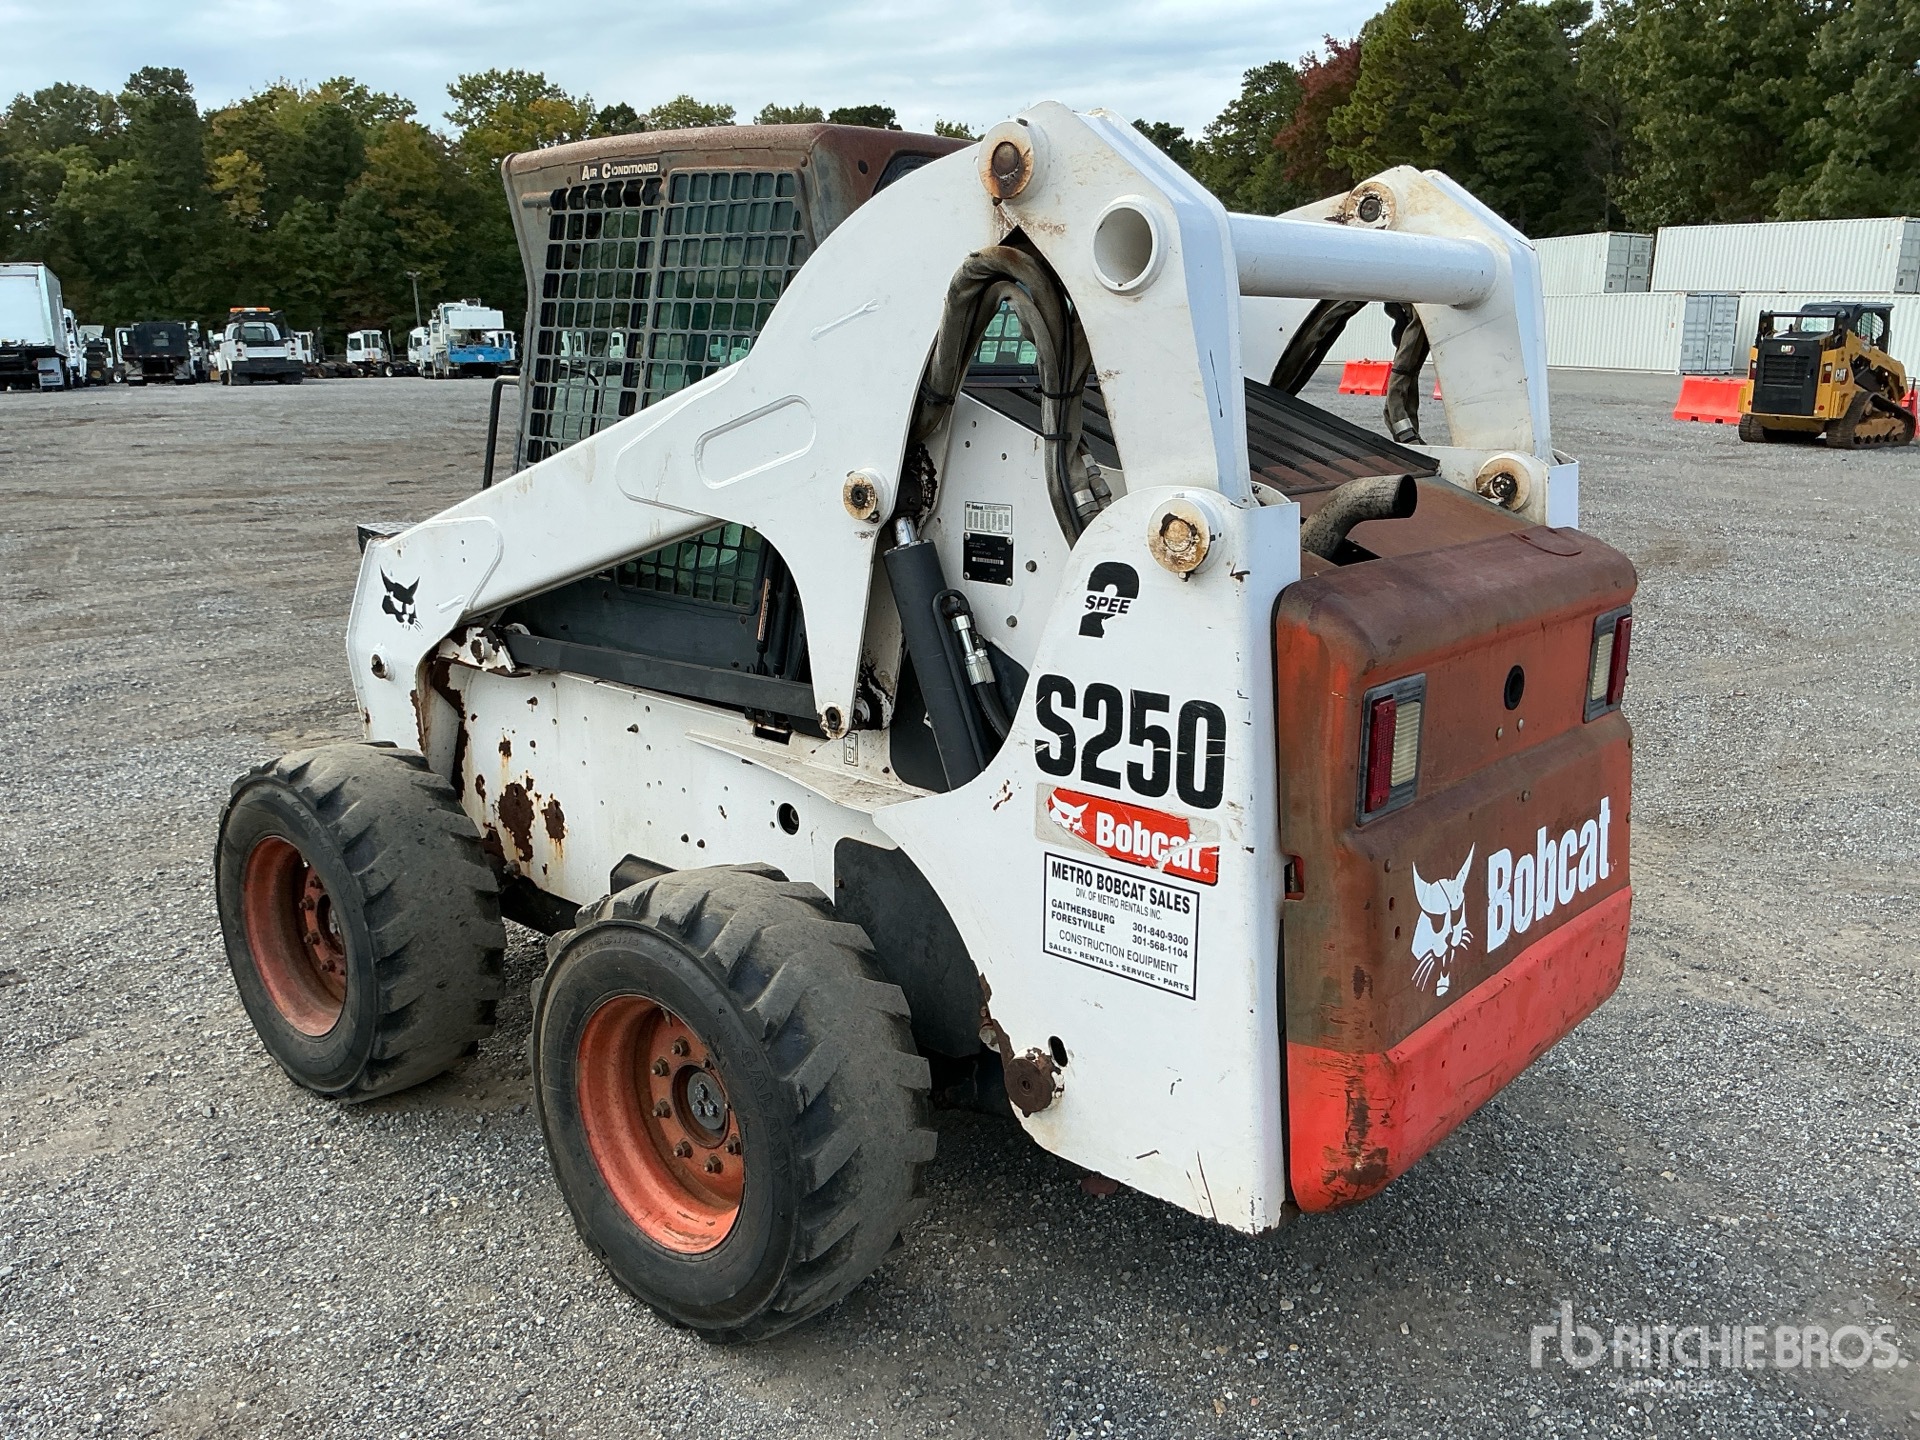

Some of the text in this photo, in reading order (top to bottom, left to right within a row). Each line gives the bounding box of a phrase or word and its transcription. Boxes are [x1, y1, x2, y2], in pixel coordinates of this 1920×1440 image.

[1034, 674, 1227, 810] S250
[1051, 860, 1191, 915] METRO BOBCAT SALES
[1487, 796, 1611, 954] Bobcat
[1051, 898, 1189, 946] GAITHERSBURG 301-840-9300
[1088, 891, 1097, 902] OF
[1097, 894, 1119, 908] METRO
[1120, 900, 1149, 916] RENTALS
[1051, 910, 1188, 959] FORESTVILLE 301-568-1104
[1059, 929, 1179, 974] CONSTRUCTION EQUIPMENT
[1048, 942, 1190, 992] SALES RENTALS SERVICE PARTS
